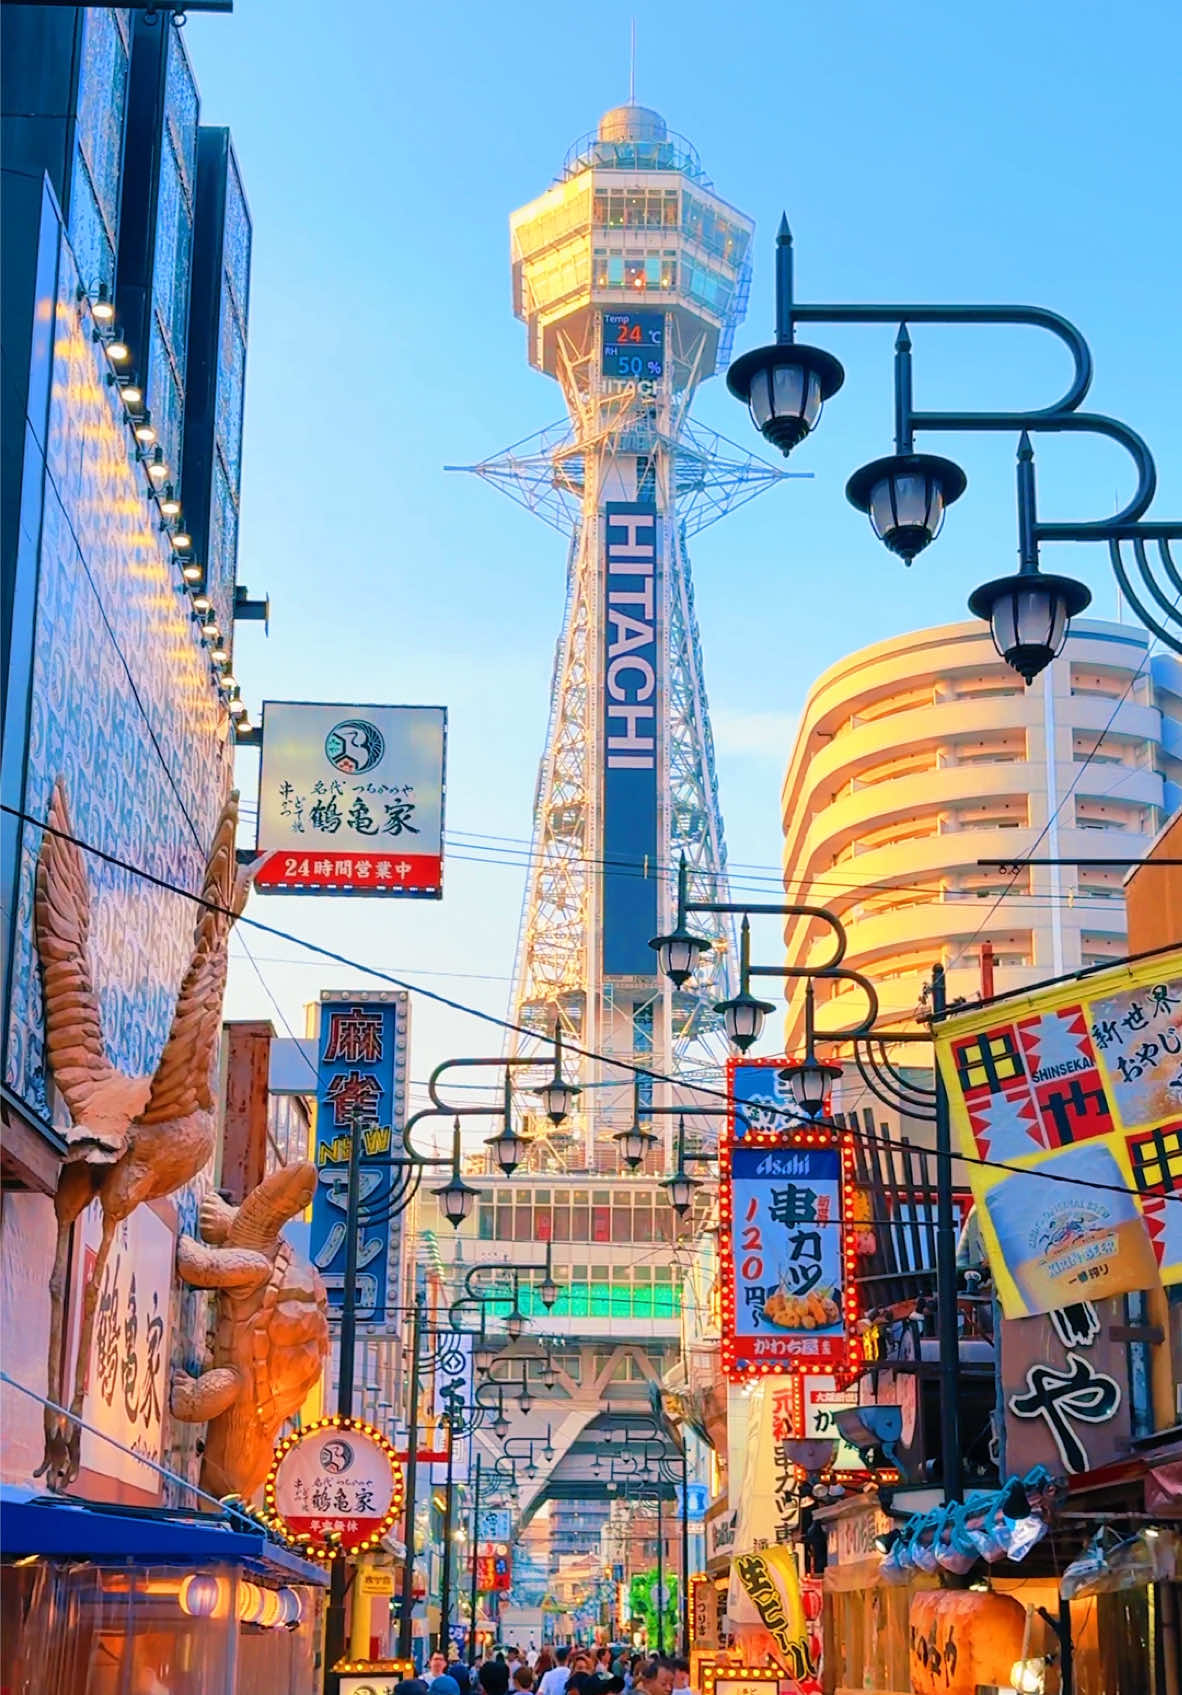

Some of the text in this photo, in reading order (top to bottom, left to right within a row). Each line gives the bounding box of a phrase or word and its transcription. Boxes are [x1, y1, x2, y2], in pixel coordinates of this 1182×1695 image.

[605, 315, 630, 324] Temp
[617, 325, 642, 342] 24
[618, 357, 661, 374] 50 %
[607, 514, 655, 769] HITACHI
[309, 795, 420, 836] 鶴亀家
[284, 857, 412, 880] 24時間営業中
[1091, 984, 1181, 1050] 新世界
[322, 1007, 384, 1126] 麻雀
[1031, 1056, 1095, 1083] SHINSEKAI
[1117, 1027, 1182, 1083] おやじ
[755, 1153, 812, 1176] Asahi
[769, 1183, 823, 1296] 串カツ
